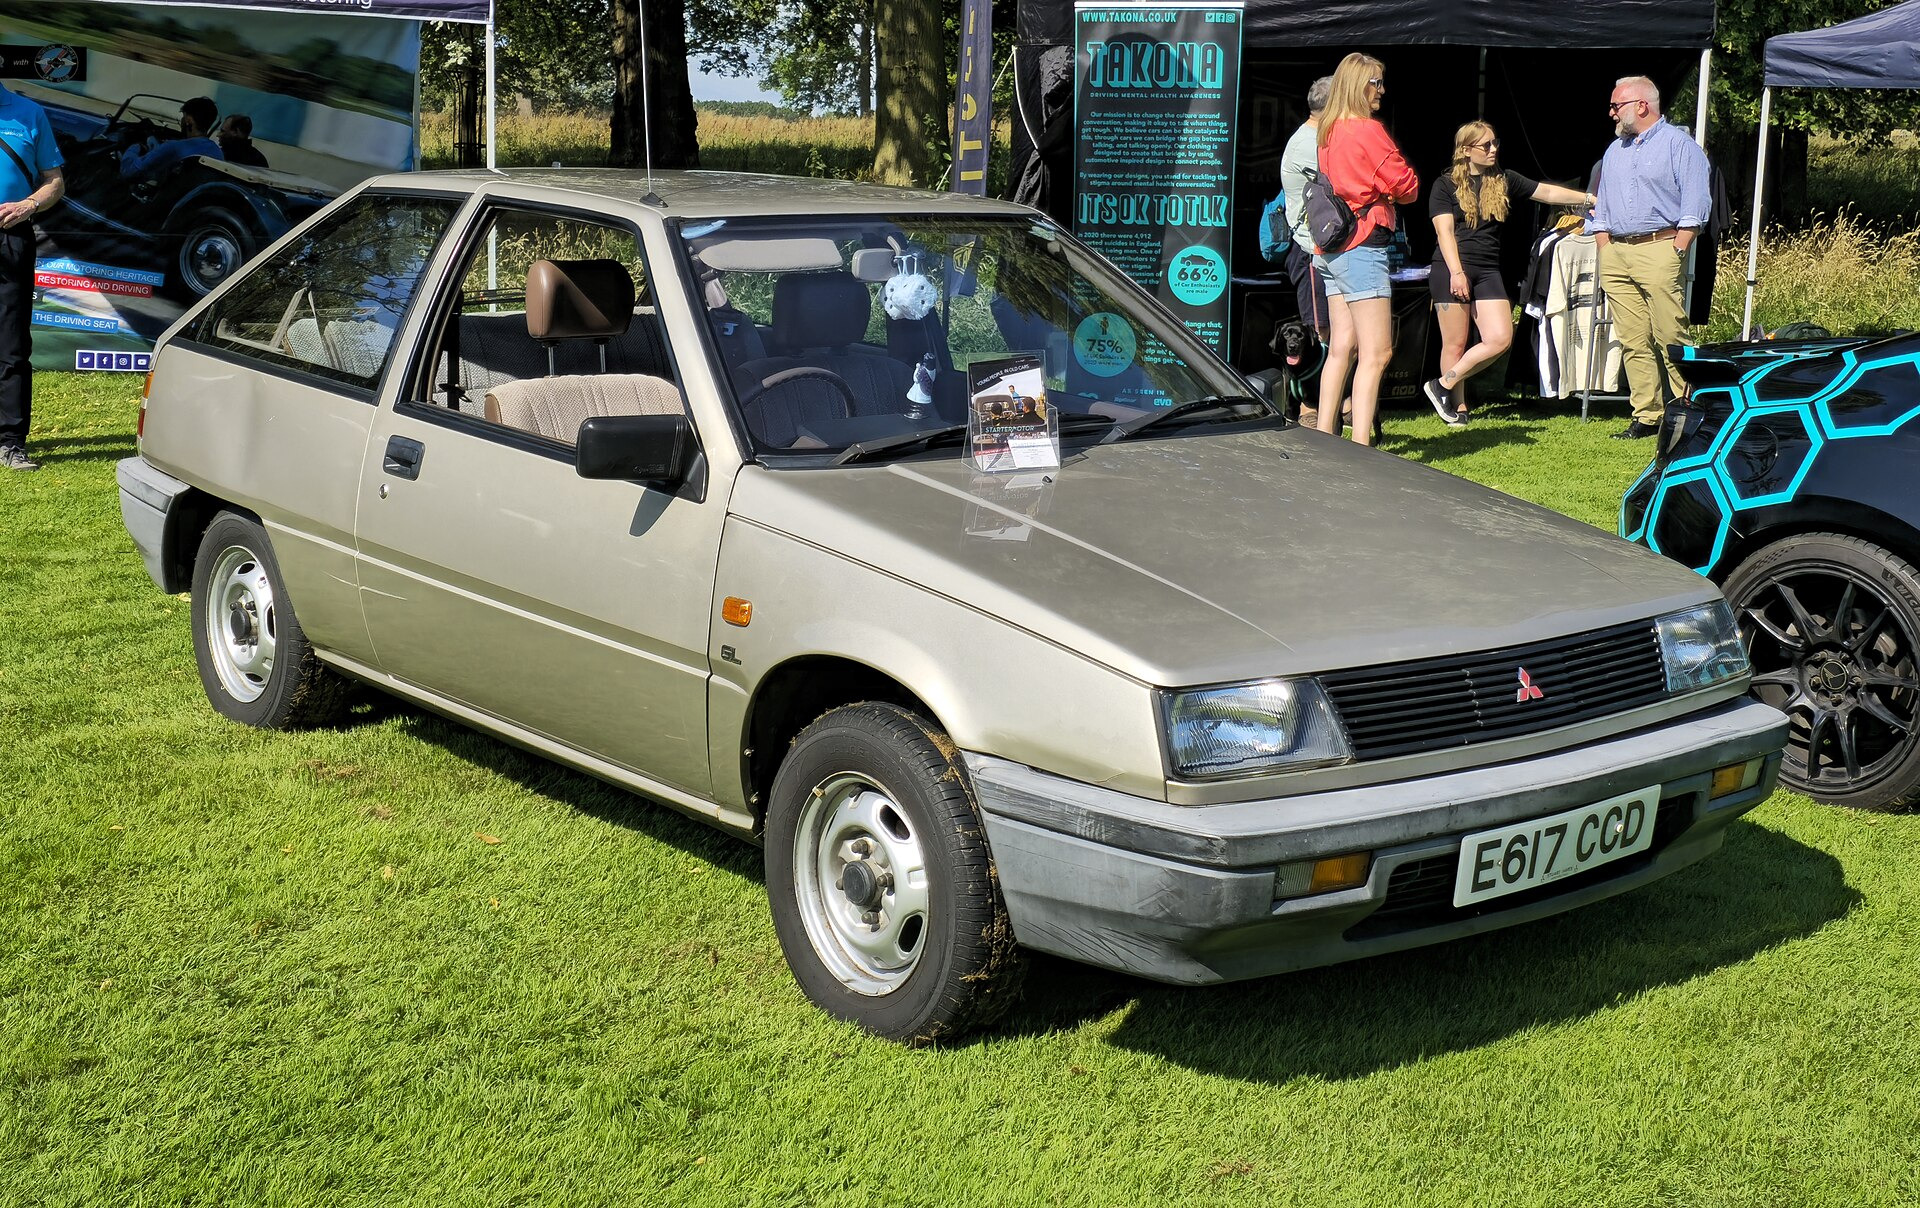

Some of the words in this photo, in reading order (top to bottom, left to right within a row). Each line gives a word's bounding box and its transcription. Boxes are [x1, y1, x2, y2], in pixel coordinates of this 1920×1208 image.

[1082, 12, 1177, 23] WWW.TAKONA.CO.UK
[1086, 41, 1224, 89] TAKONA
[1141, 111, 1163, 119] change
[1123, 119, 1146, 127] making
[1153, 119, 1168, 127] okay
[1094, 134, 1118, 142] through
[1128, 142, 1149, 150] talking
[1150, 142, 1172, 150] openly.
[1094, 149, 1121, 157] designed
[1164, 150, 1186, 158] bridge,
[1119, 157, 1144, 165] inspired
[1199, 158, 1222, 166] people.
[1124, 172, 1150, 180] designs,
[47, 261, 64, 269] OUR
[65, 264, 114, 276] MOTORING
[116, 270, 160, 284] HERITAGE
[1177, 268, 1218, 282] 66%
[38, 275, 90, 288] RESTORING
[91, 281, 110, 290] AND
[112, 283, 149, 294] DRIVING
[35, 313, 52, 322] THE
[54, 316, 91, 327] DRIVING
[93, 320, 116, 330] SEAT
[1209, 337, 1219, 345] for
[1086, 339, 1122, 354] 75%
[976, 376, 991, 386] YOUNG
[990, 371, 1004, 381] PEOPLE
[1153, 398, 1173, 406] evo
[1470, 822, 1568, 893] E617
[1576, 800, 1645, 862] CCD
